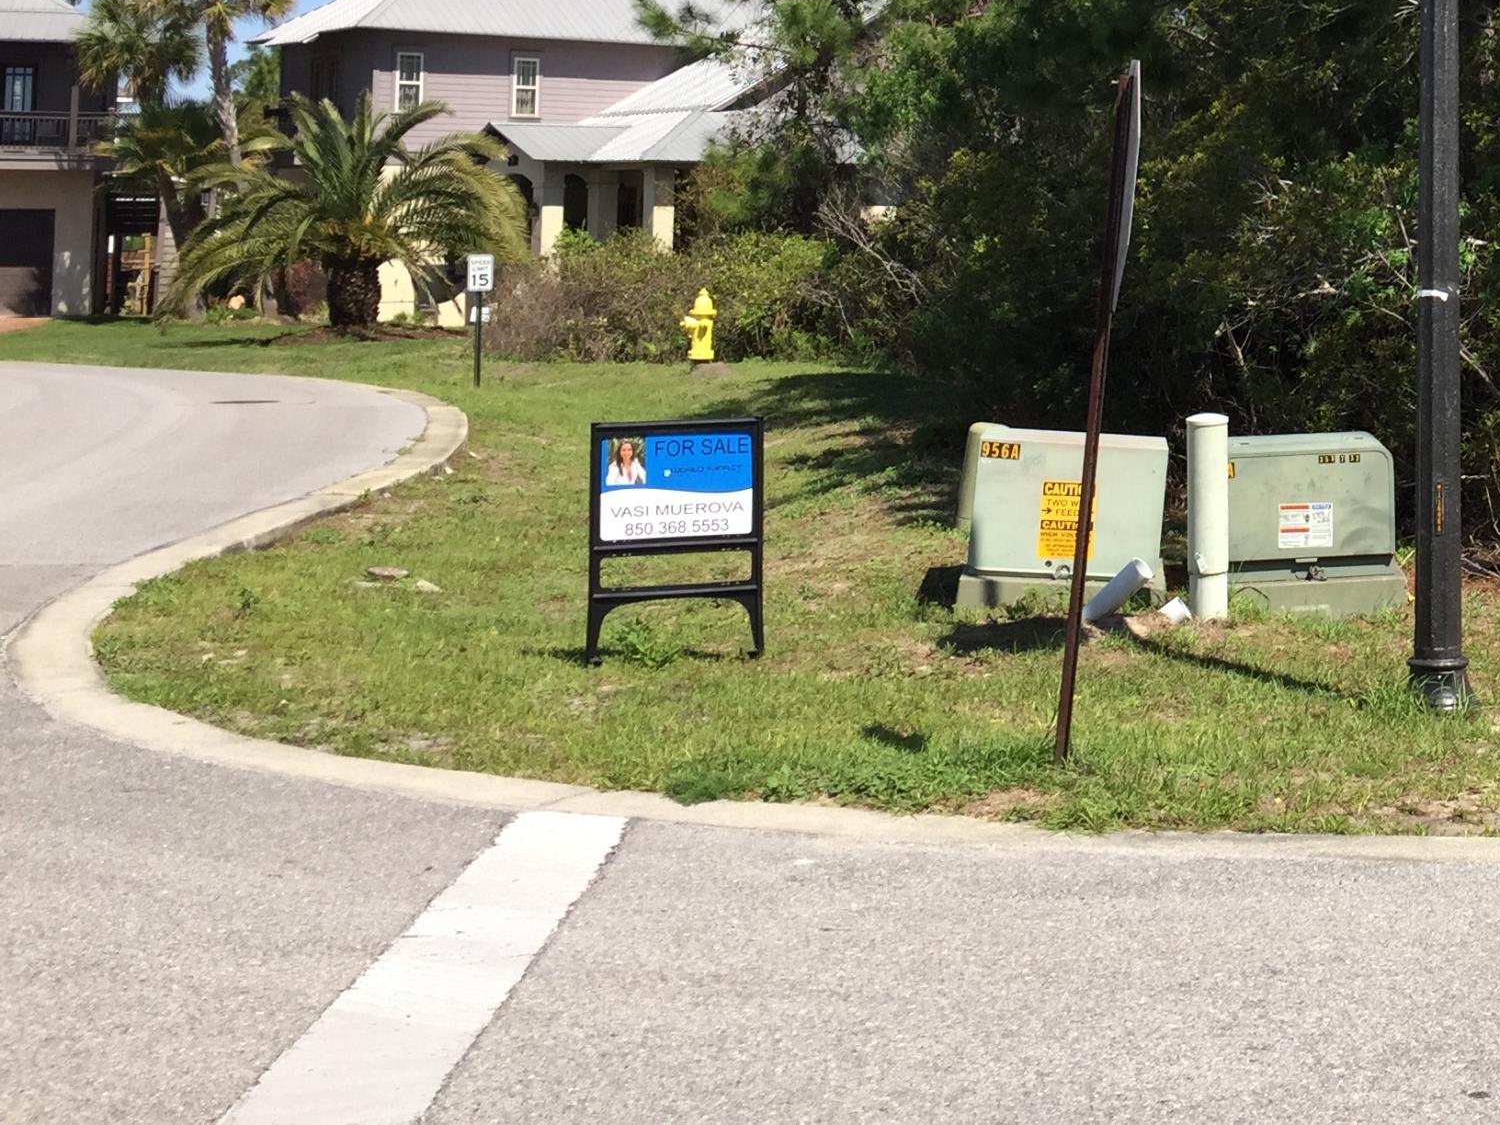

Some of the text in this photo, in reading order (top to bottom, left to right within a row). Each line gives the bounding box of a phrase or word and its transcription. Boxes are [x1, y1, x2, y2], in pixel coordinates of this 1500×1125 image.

[472, 273, 489, 287] 15
[654, 437, 749, 457] FOR SALE
[982, 442, 1019, 459] 956A
[1044, 483, 1082, 496] CAUTI
[610, 501, 744, 518] VASI MUEROVA
[1046, 498, 1068, 507] TWO
[1041, 520, 1079, 530] CAUTI
